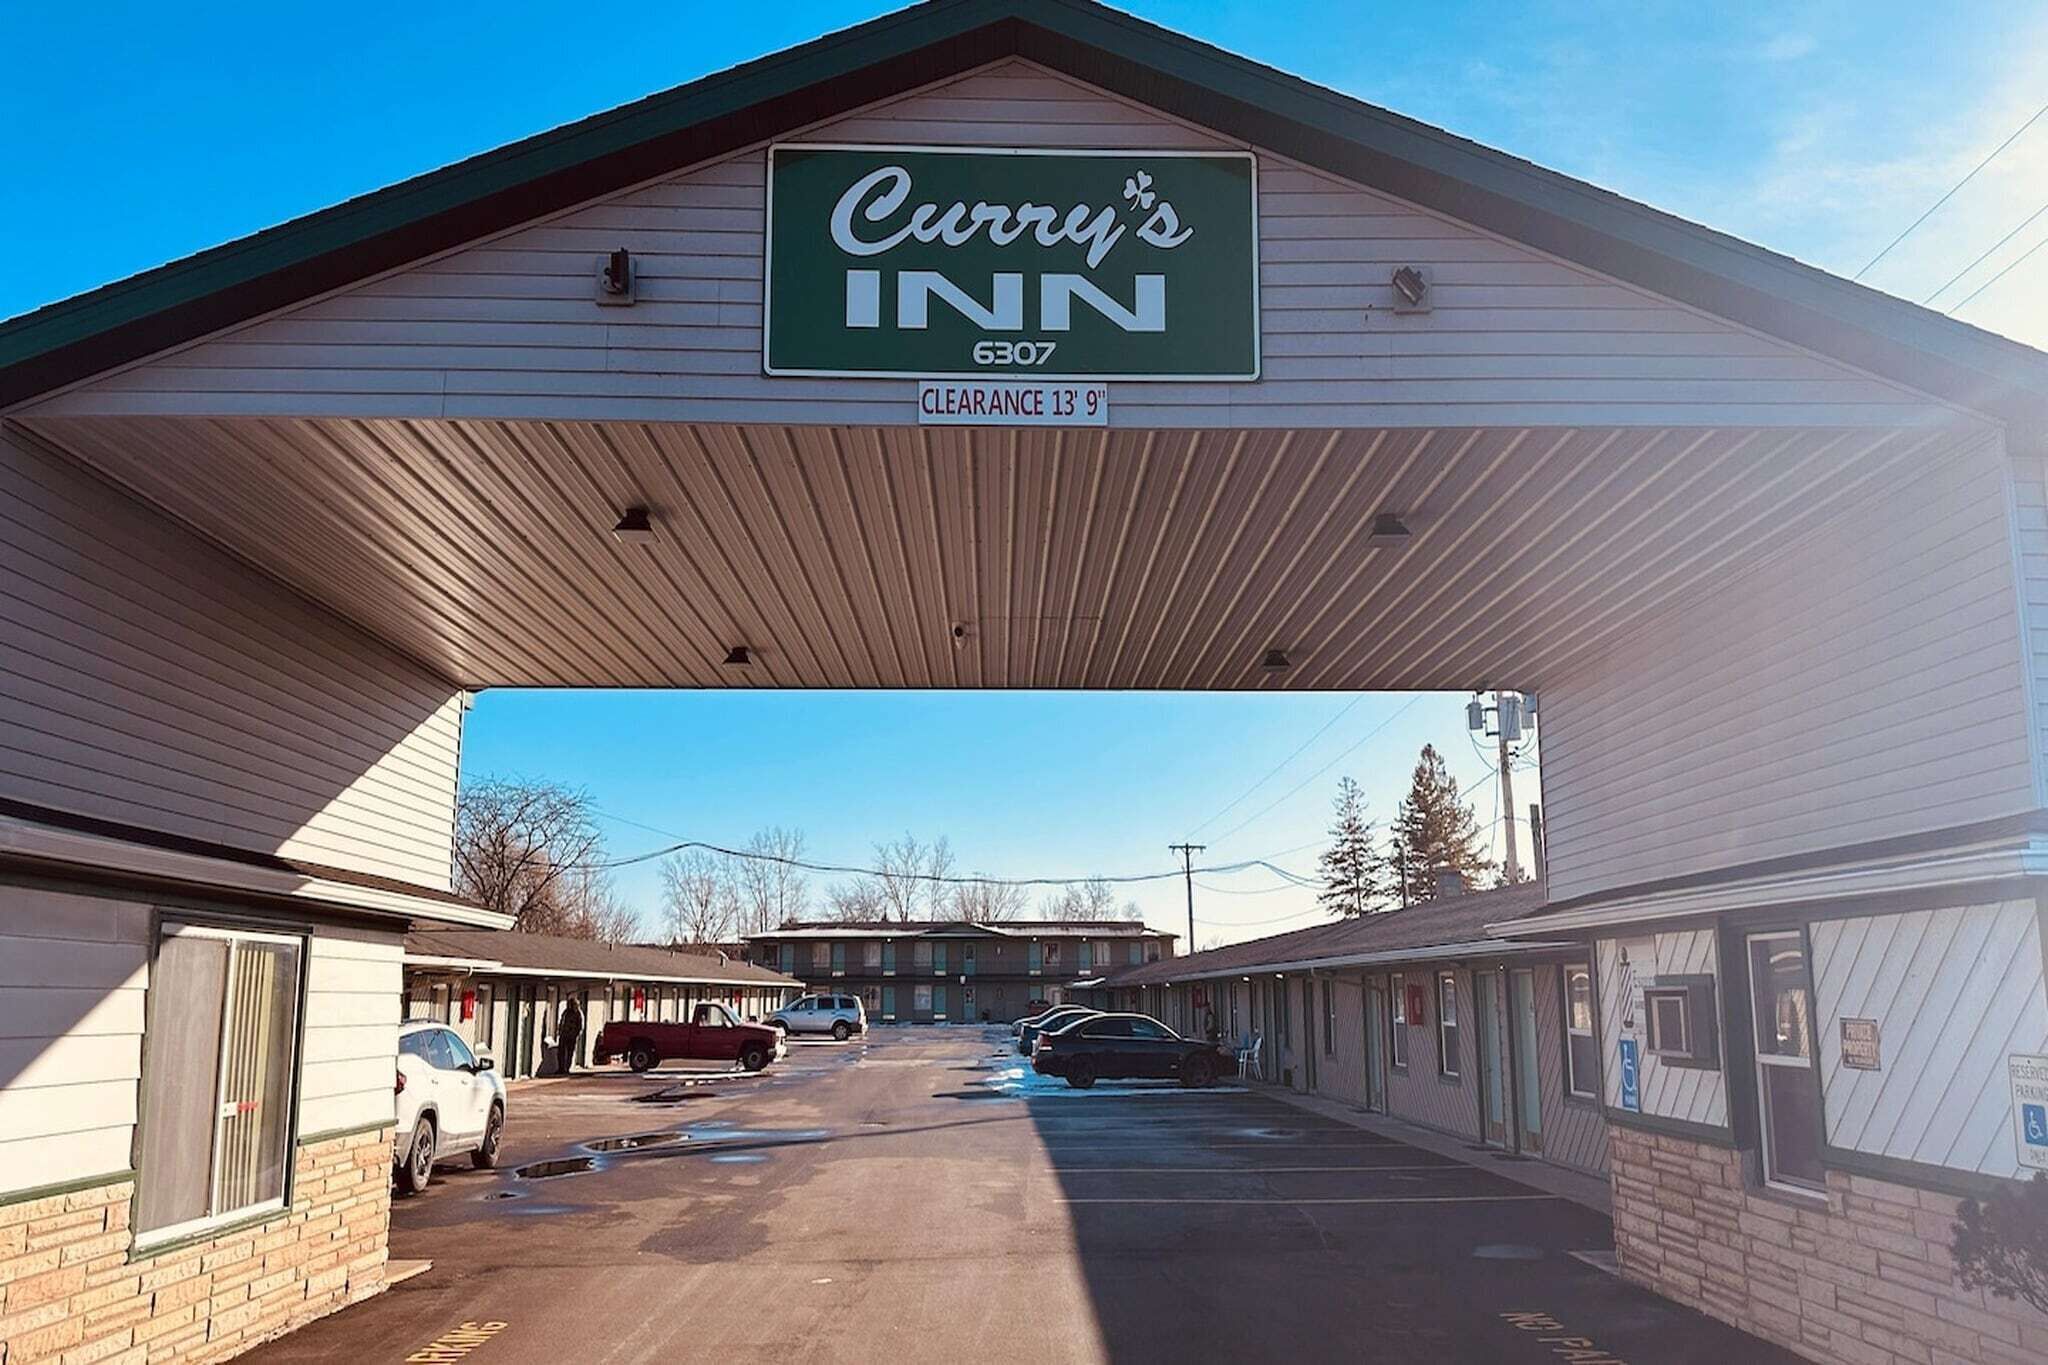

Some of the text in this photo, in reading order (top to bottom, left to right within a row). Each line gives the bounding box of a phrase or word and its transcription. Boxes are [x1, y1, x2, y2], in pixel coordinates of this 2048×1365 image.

[830, 165, 1194, 270] Curry's
[846, 270, 1166, 332] INN
[973, 341, 1057, 366] 6307
[921, 388, 1106, 416] CLEARANCE 13' 9"
[404, 1321, 508, 1365] RKING
